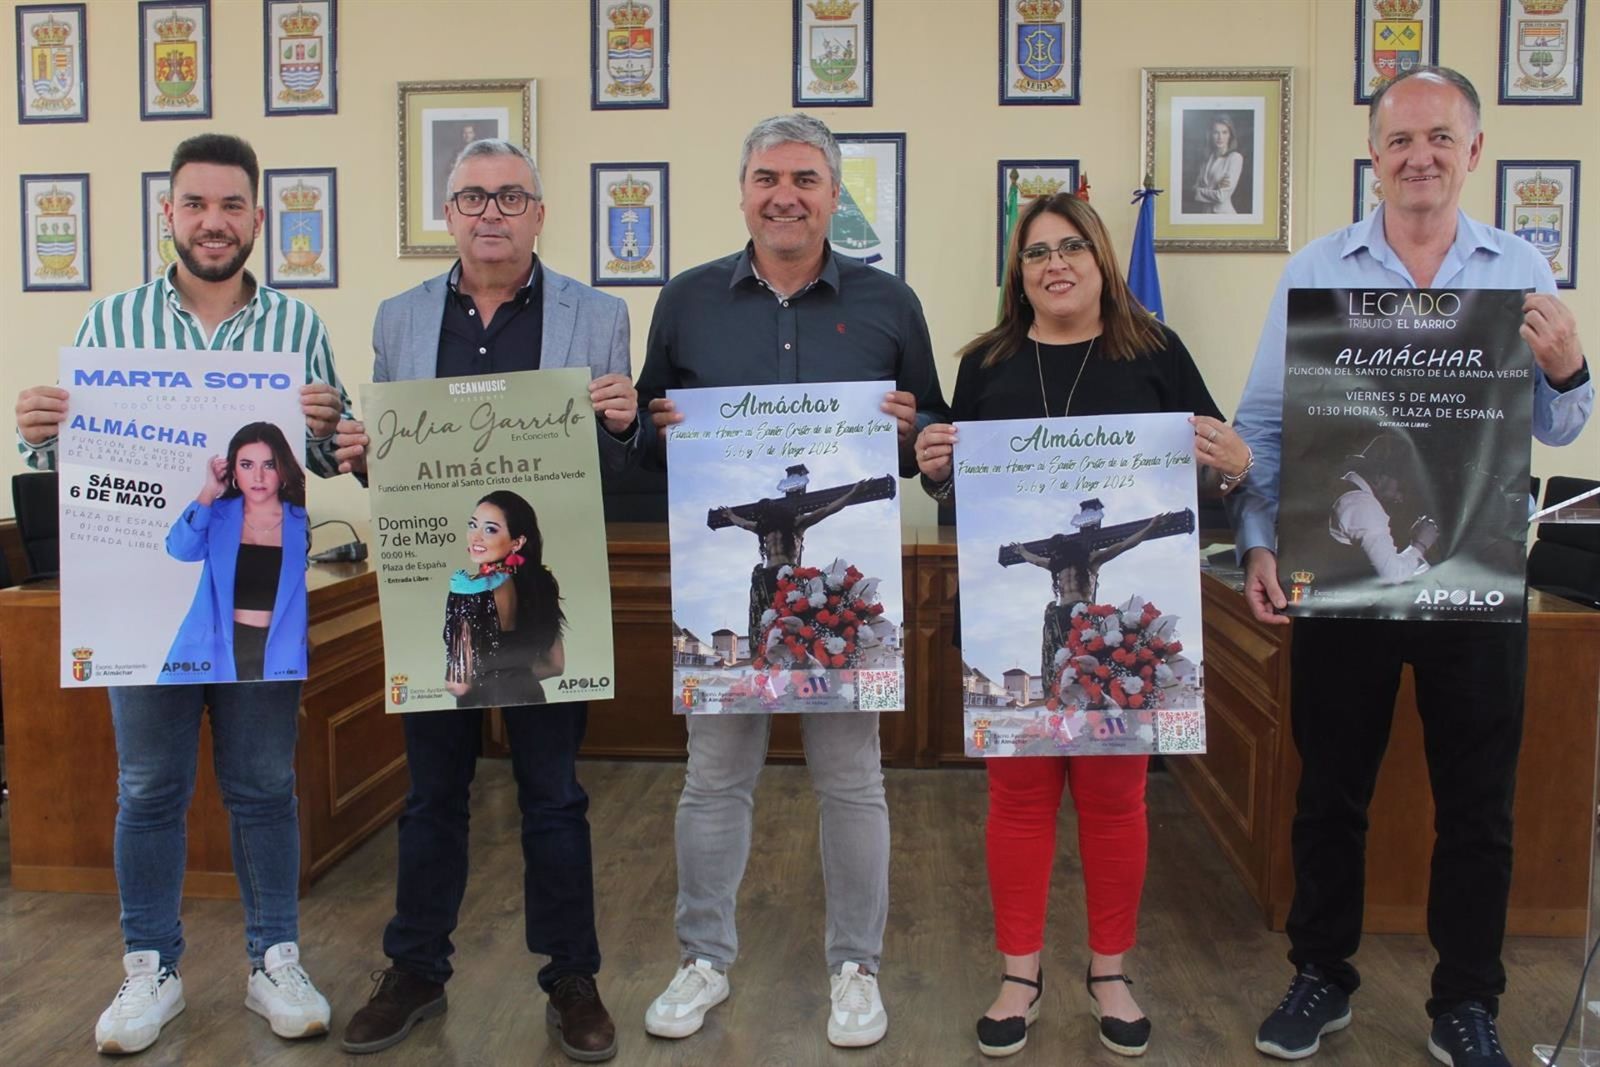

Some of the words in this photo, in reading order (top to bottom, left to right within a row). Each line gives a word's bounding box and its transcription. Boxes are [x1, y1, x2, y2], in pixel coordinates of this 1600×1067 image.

[1349, 292, 1461, 316] LEGADO
[1349, 318, 1392, 329] TRIBUTO
[1335, 344, 1483, 367] ALMÁCHAR
[74, 370, 192, 388] MARTA
[204, 372, 291, 390] SOTO
[1288, 366, 1332, 376] FUNCIÓN
[1334, 367, 1352, 376] DEL
[1355, 368, 1387, 376] SANTO
[1390, 368, 1425, 377] CRISTO
[1428, 368, 1441, 377] DE
[1443, 369, 1456, 378] LA
[1459, 370, 1494, 379] BANDA
[1497, 369, 1529, 379] VERDE
[449, 379, 506, 395] OCEANMUSIC
[720, 392, 840, 418] Almáchar
[1346, 391, 1395, 402] VIERNES
[1399, 392, 1406, 402] 5
[1410, 392, 1426, 403] DE
[1430, 393, 1466, 404] MAYO
[1308, 406, 1340, 416] 01:30
[1343, 406, 1389, 418] HORAS,
[1392, 407, 1432, 418] PLAZA
[1436, 408, 1452, 418] DE
[1456, 406, 1504, 419] ESPAÑA
[70, 414, 207, 448] ALMÁCHAR
[376, 409, 462, 460] Julia
[470, 398, 585, 452] Garrido
[511, 433, 522, 442] En
[523, 431, 559, 441] Concierto
[669, 425, 700, 441] Función
[716, 425, 743, 439] Honor
[756, 422, 783, 440] Santo
[786, 422, 811, 439] Cristo
[813, 425, 821, 434] de
[824, 424, 832, 434] la
[835, 420, 864, 437] Banda
[868, 419, 893, 435] Verde
[72, 436, 125, 449] FUNCIÓN
[153, 447, 193, 458] HONOR
[1010, 425, 1136, 452] Almáchar
[98, 447, 136, 458] SANTO
[144, 452, 186, 464] CRISTO
[767, 445, 775, 455] de
[781, 441, 805, 458] Mayo
[808, 441, 839, 455] 2023
[110, 456, 148, 467] BANDA
[156, 462, 192, 473] VERDE
[418, 455, 542, 480] Almáchar
[958, 459, 989, 476] Función
[1006, 459, 1035, 473] Honor
[1049, 456, 1077, 474] Santo
[1080, 456, 1106, 472] Cristo
[1108, 458, 1116, 467] de
[1120, 457, 1128, 467] la
[1131, 453, 1161, 470] Banda
[1165, 450, 1191, 468] Verde
[89, 474, 163, 494] SÁBADO
[378, 483, 409, 493] Función
[424, 481, 450, 490] Honor
[451, 479, 459, 488] al
[460, 478, 485, 488] Santo
[486, 475, 510, 486] Cristo
[512, 475, 524, 484] de
[525, 474, 532, 483] la
[534, 472, 560, 482] Banda
[561, 470, 586, 480] Verde
[1060, 480, 1068, 489] de
[1075, 475, 1100, 492] Mayo
[1103, 475, 1135, 489] 2023
[70, 486, 80, 497] 6
[87, 488, 110, 502] DE
[115, 492, 166, 509] MAYO
[65, 509, 101, 520] PLAZA
[107, 514, 122, 524] DE
[127, 516, 169, 529] ESPAÑA
[379, 516, 448, 533] Domingo
[115, 527, 153, 538] HORAS
[380, 535, 388, 547] 7
[392, 533, 411, 547] de
[415, 531, 457, 548] Mayo
[70, 533, 122, 546] ENTRADA
[128, 540, 159, 551] LIBRE
[381, 551, 403, 560] 00:00
[404, 551, 417, 559] Hs.
[382, 563, 403, 573] Plaza
[405, 563, 415, 571] de
[416, 561, 447, 572] España
[1414, 589, 1504, 606] APOLO
[161, 661, 211, 673] APOLO
[558, 677, 610, 690] APOLO
